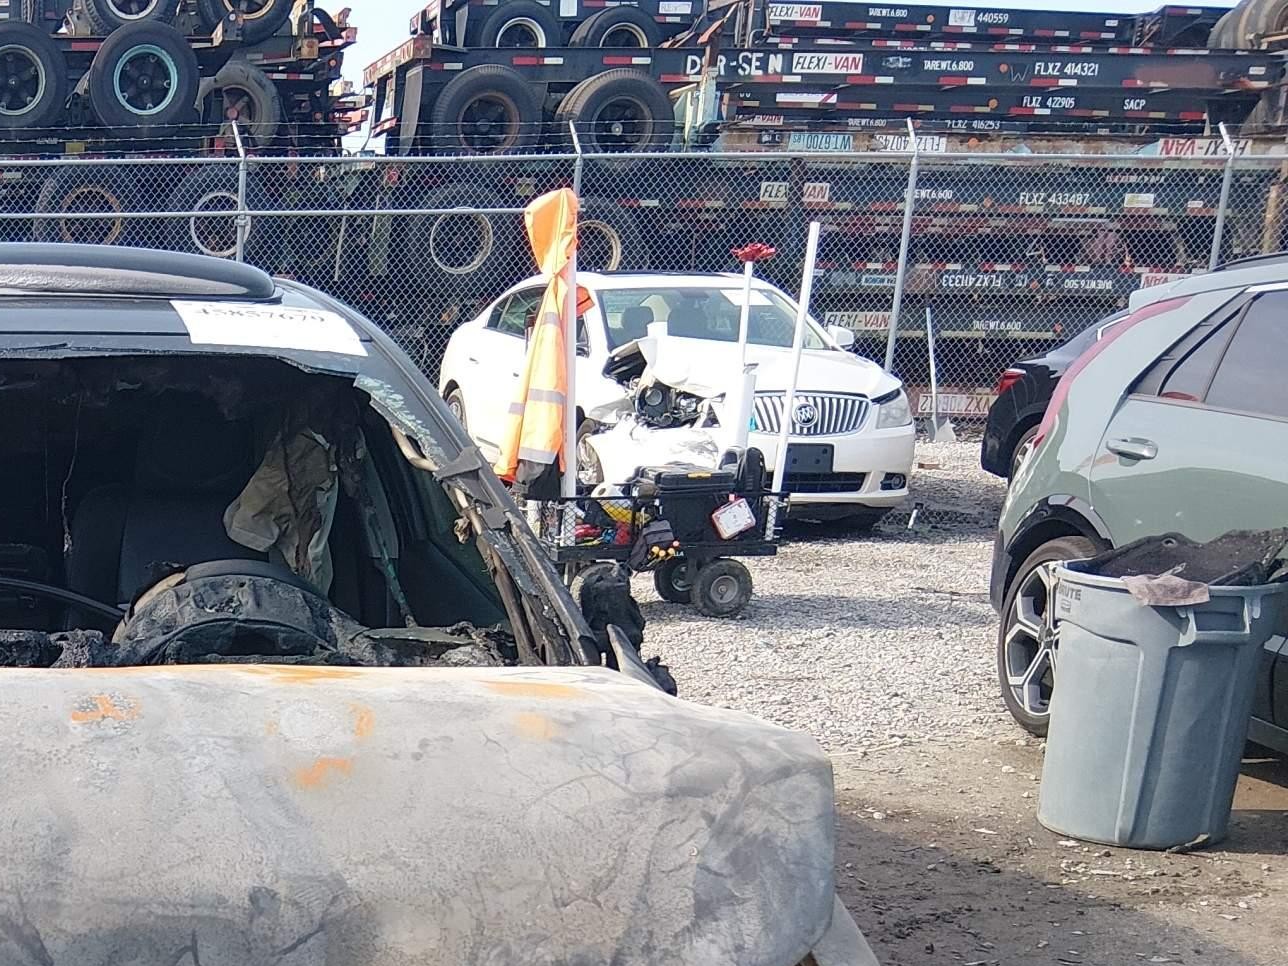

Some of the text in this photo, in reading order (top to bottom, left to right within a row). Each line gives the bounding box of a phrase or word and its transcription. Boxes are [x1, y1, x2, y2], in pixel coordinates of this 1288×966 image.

[769, 5, 820, 18] FLEXI-VAN
[977, 13, 1009, 24] 440559
[794, 55, 861, 72] FLEXI-VAN
[1034, 62, 1099, 76] FLXZ 414321
[1022, 96, 1075, 109] FLXZ 422905
[1123, 99, 1146, 110] SACP
[762, 184, 828, 199] FLEXAN
[1019, 192, 1090, 206] FLXZ 433487
[975, 274, 1002, 287] FLXZ
[825, 313, 891, 328] FLEXI-VAN
